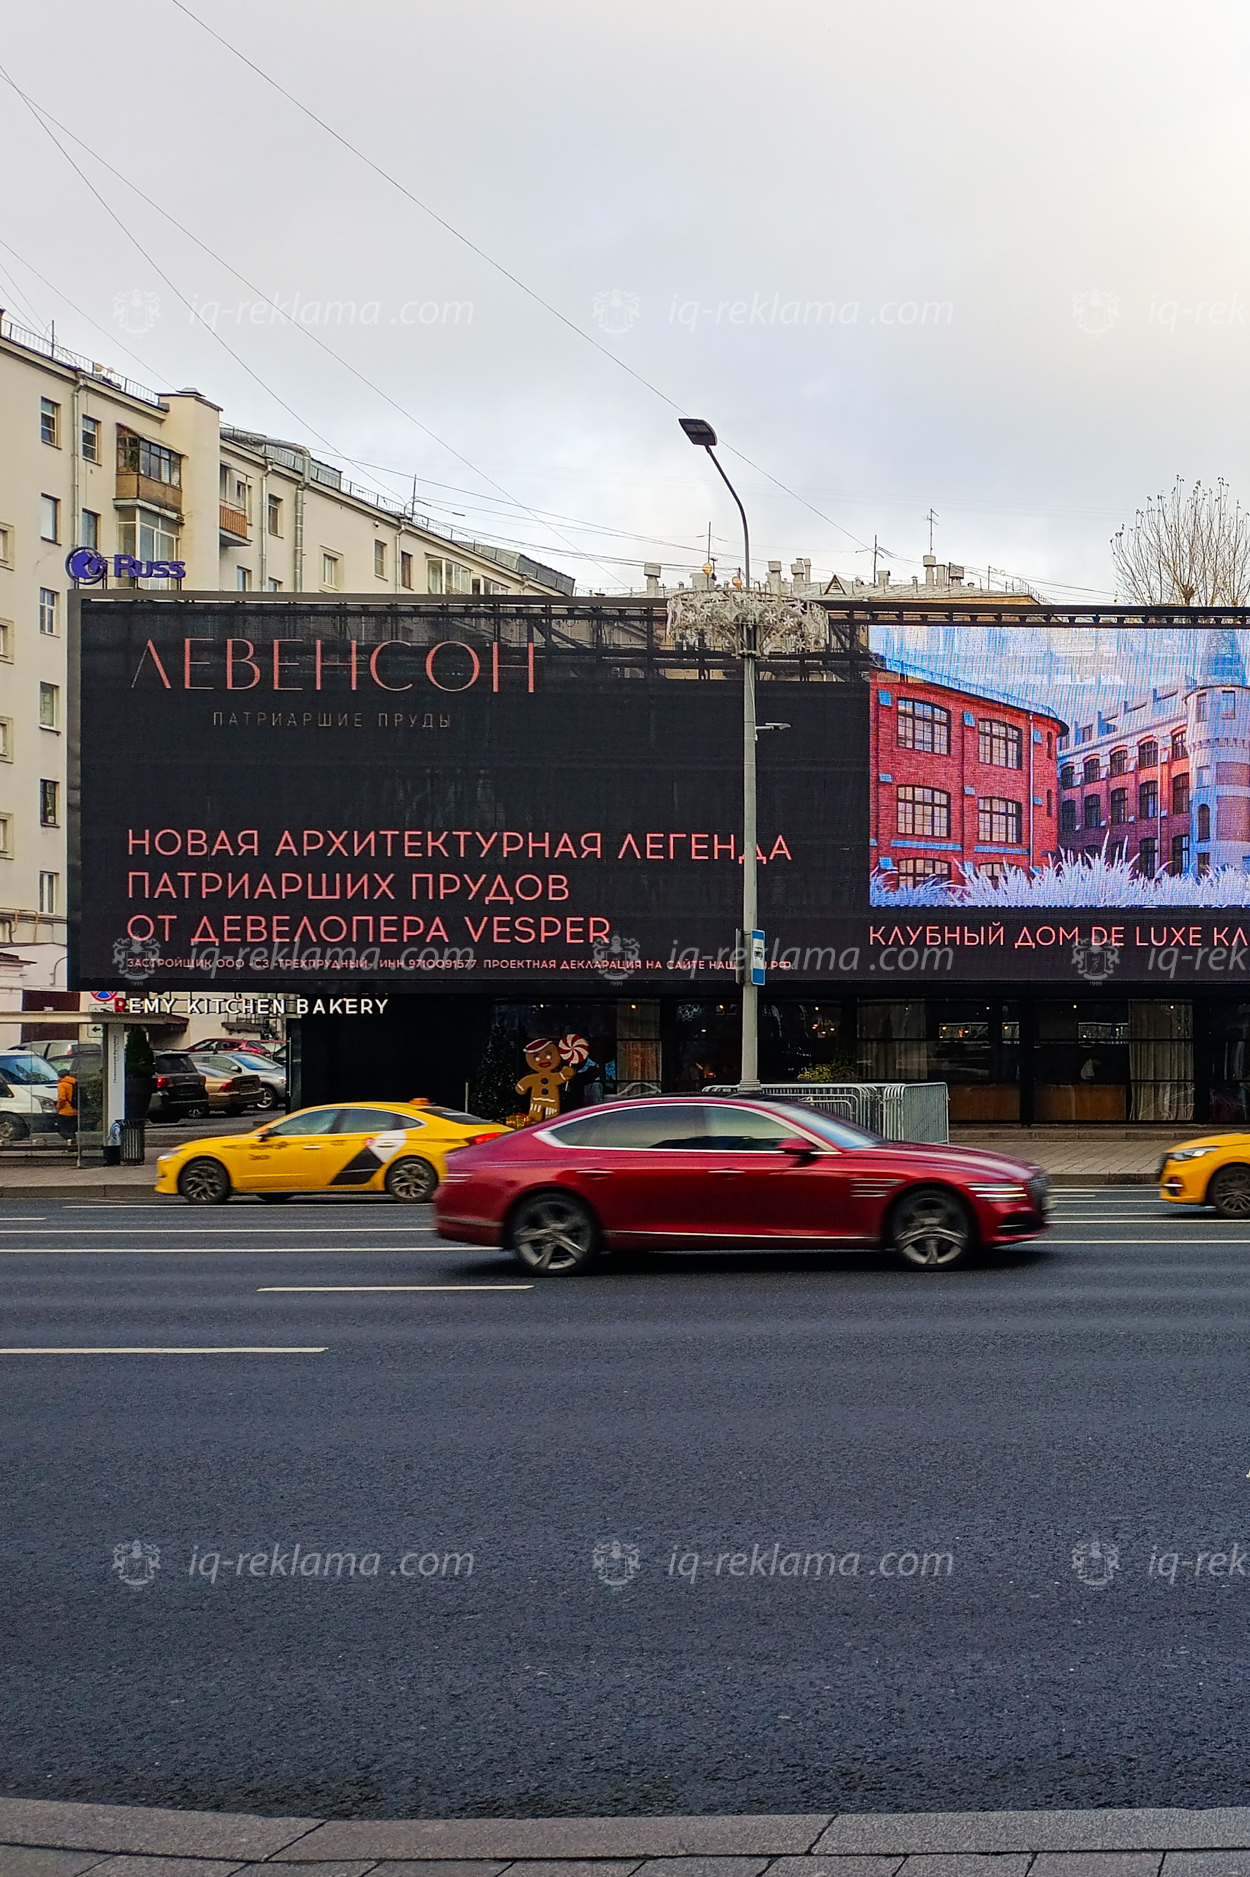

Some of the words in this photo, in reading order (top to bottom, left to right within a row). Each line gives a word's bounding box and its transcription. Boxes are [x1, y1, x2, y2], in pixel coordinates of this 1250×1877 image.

[114, 553, 186, 579] Russ
[131, 638, 534, 693] ЛЕВЕНСОН
[213, 712, 362, 727] ПАТРИАРШИЕ
[378, 712, 450, 728] ПРУДЫ
[127, 829, 259, 856] НОВАЯ
[275, 830, 602, 859] АРХИТЕКТУРНАЯ
[127, 871, 396, 900] ПАТРИАРШИХ
[411, 873, 570, 905] ПРУДОВ
[127, 914, 178, 943] ОТ
[190, 915, 450, 946] ДЕВЕЛОПЕРА
[464, 916, 611, 944] VESPER
[869, 921, 1005, 947] КЛУБНЫЙ
[1014, 926, 1079, 948] ДОМ
[1091, 926, 1125, 947] DE
[1135, 926, 1203, 947] LUXE
[127, 957, 212, 969] ЗАСТРОЙЩИК
[216, 958, 245, 968] ООО
[379, 959, 405, 968] ИНН
[483, 959, 557, 969] ПРОЕКТНАЯ
[560, 959, 642, 971] ДЕКЛАРАЦИЯ
[646, 960, 662, 969] НА
[666, 957, 705, 969] САЙТЕ
[114, 998, 175, 1014] REMY
[187, 998, 285, 1014] KITCHEN
[297, 998, 388, 1015] BAKERY
